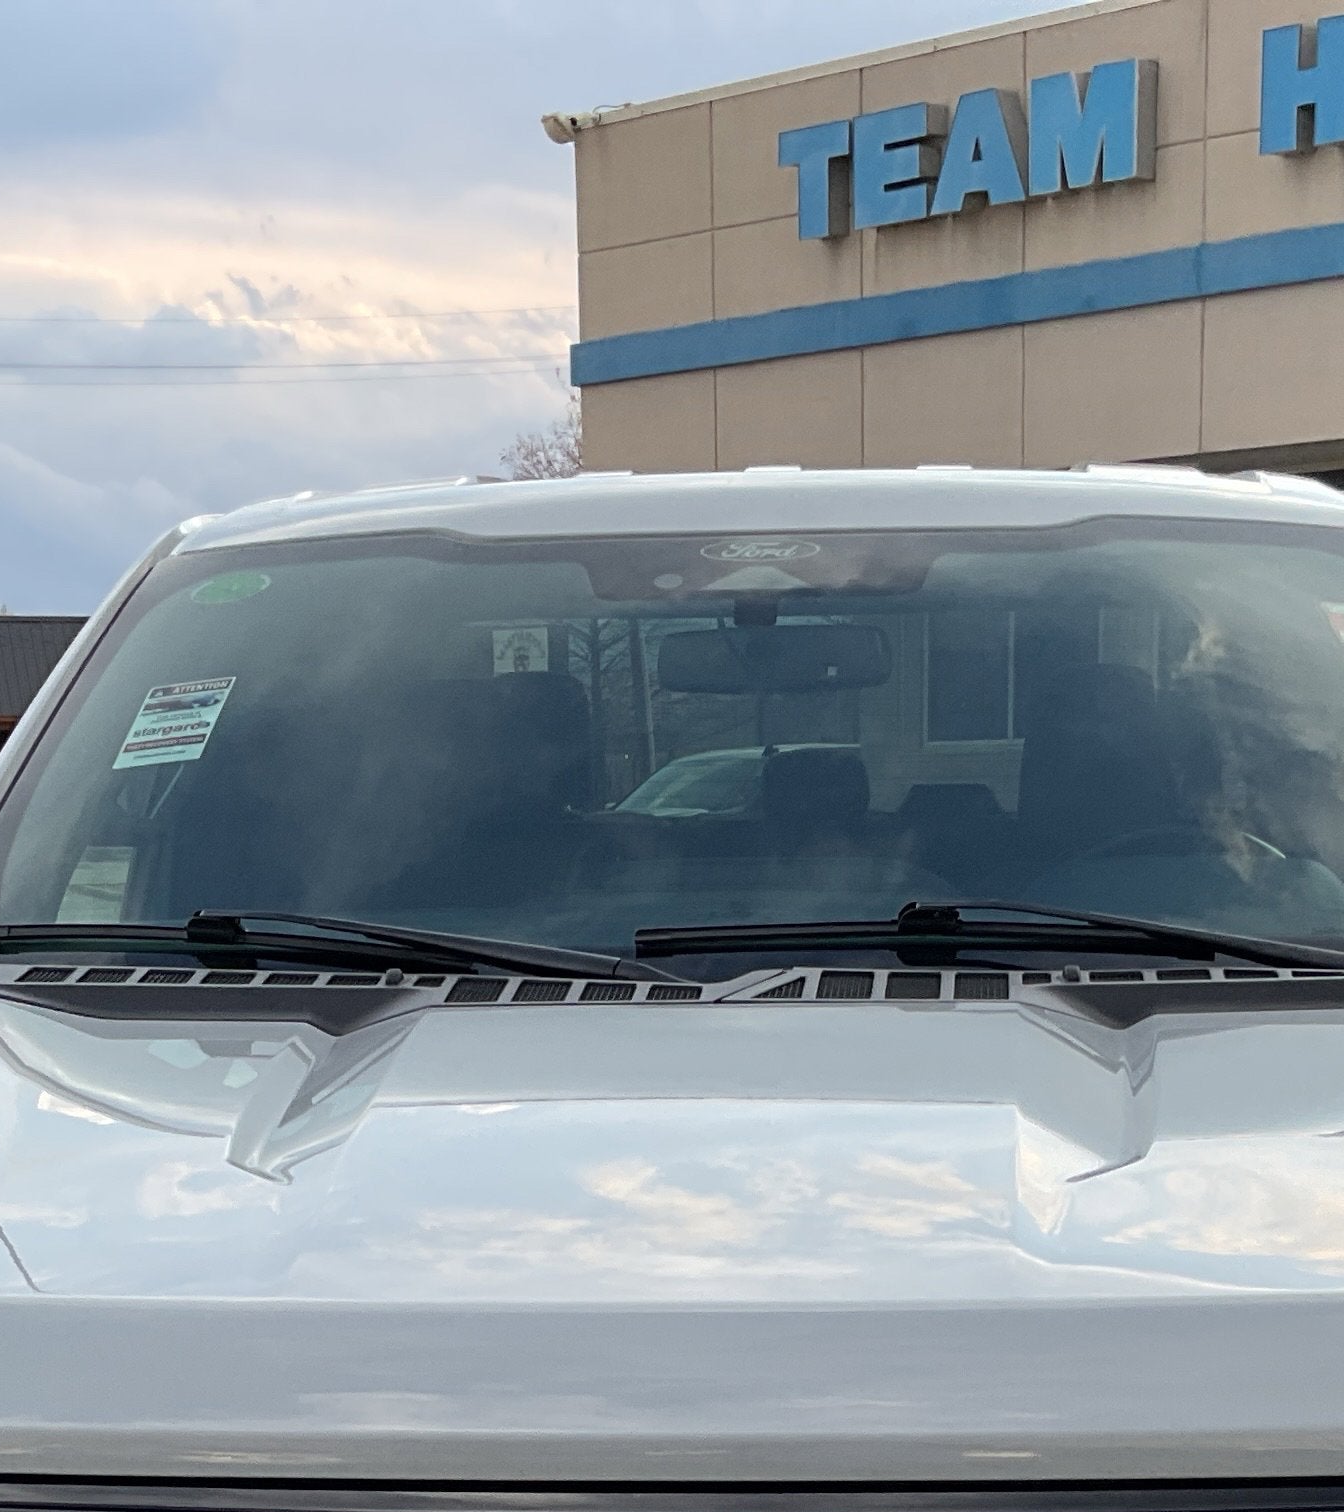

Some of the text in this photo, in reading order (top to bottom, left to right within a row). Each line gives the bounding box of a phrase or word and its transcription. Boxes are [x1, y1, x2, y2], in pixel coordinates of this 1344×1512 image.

[778, 57, 1148, 240] TEAM
[721, 541, 799, 558] Ford
[172, 680, 230, 695] ATTENTION
